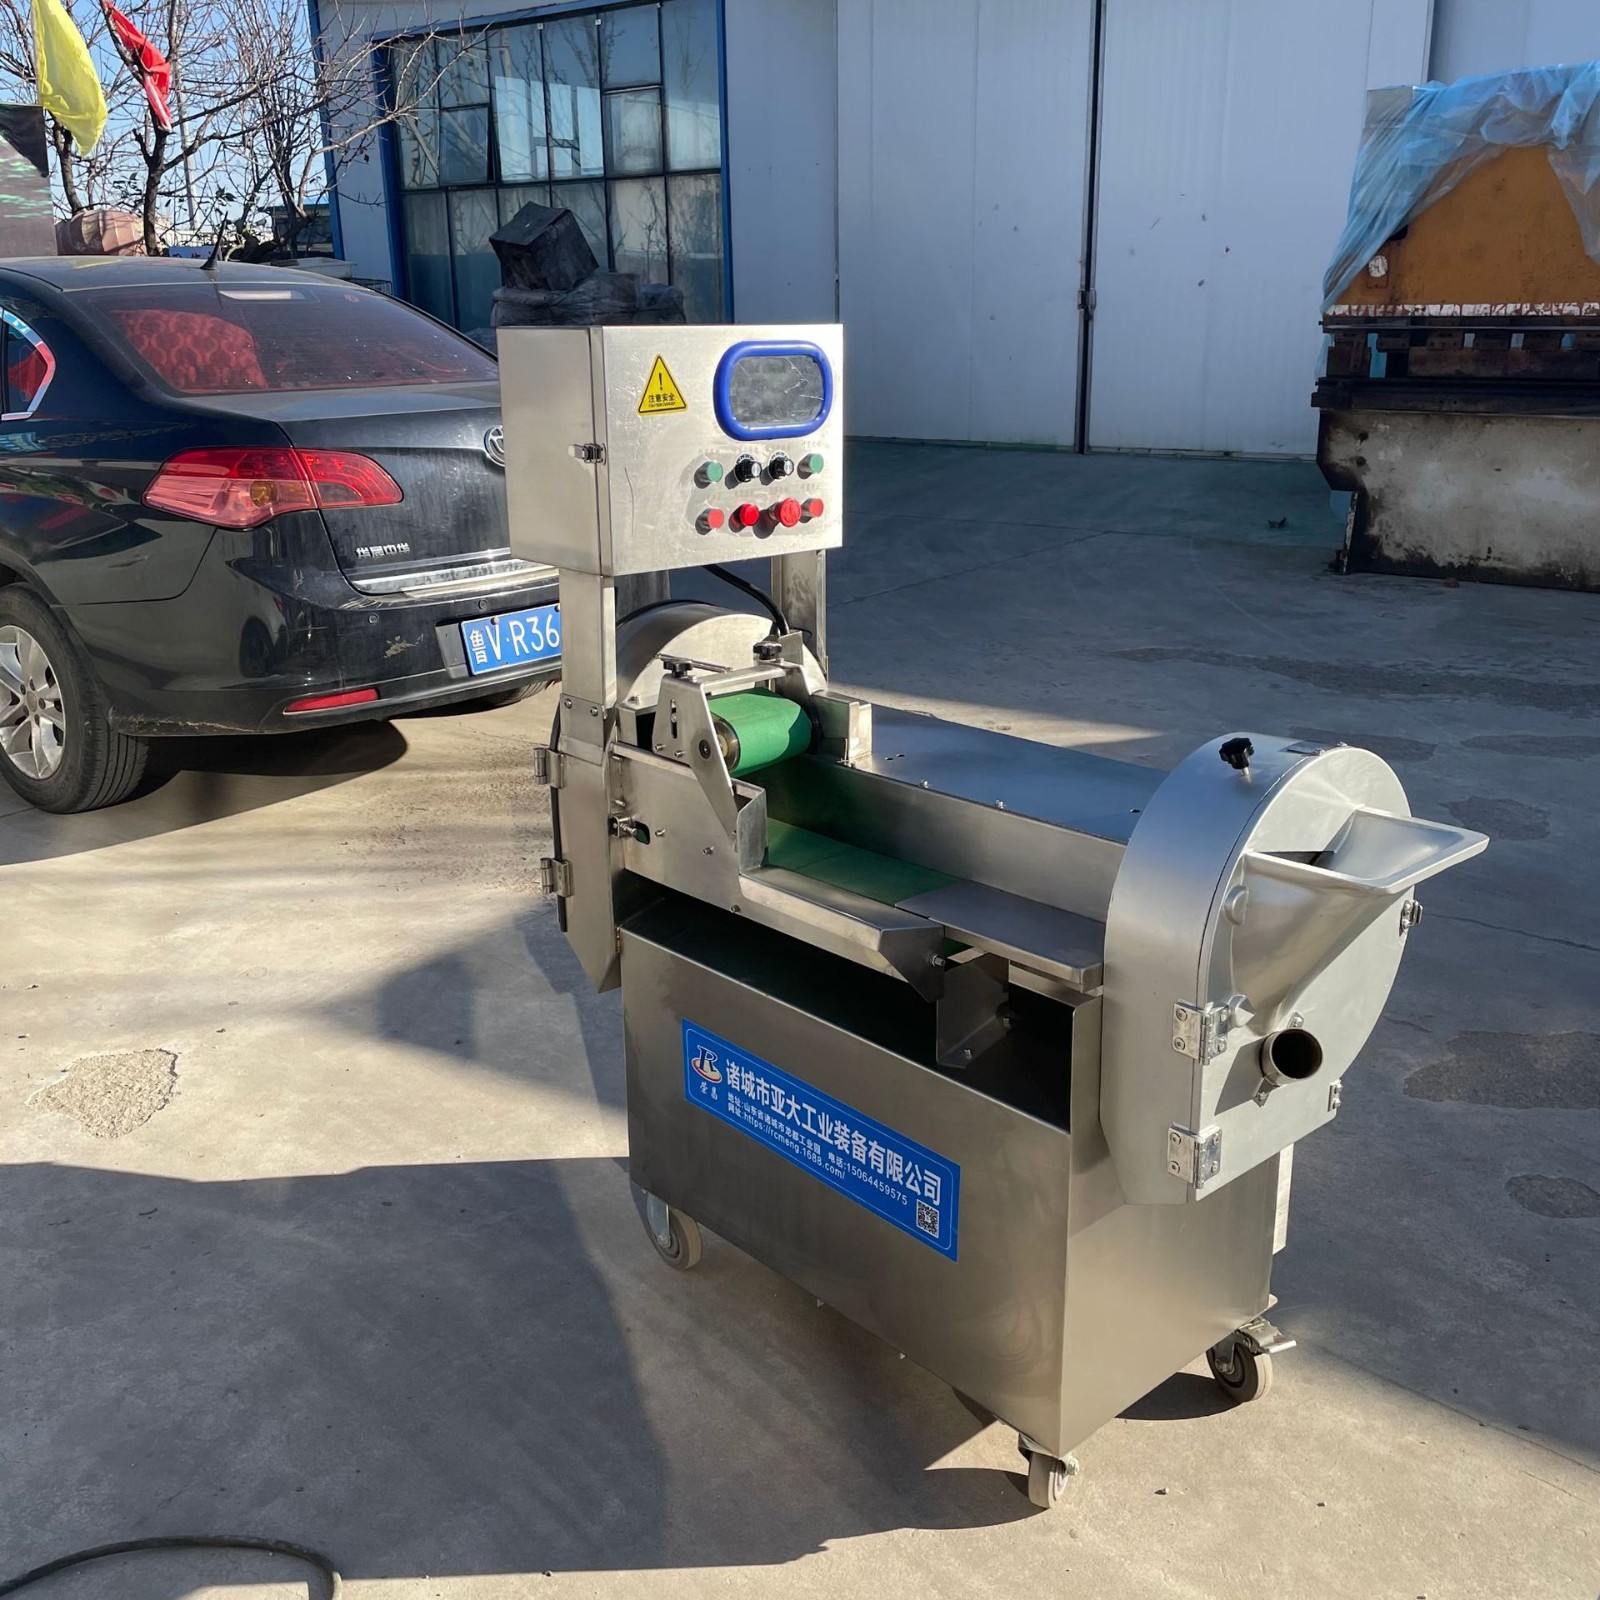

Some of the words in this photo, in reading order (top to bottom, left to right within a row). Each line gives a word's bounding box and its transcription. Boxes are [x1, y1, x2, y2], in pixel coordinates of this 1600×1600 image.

[726, 1059, 941, 1206] 诸城市亚大工业装备有限公司
